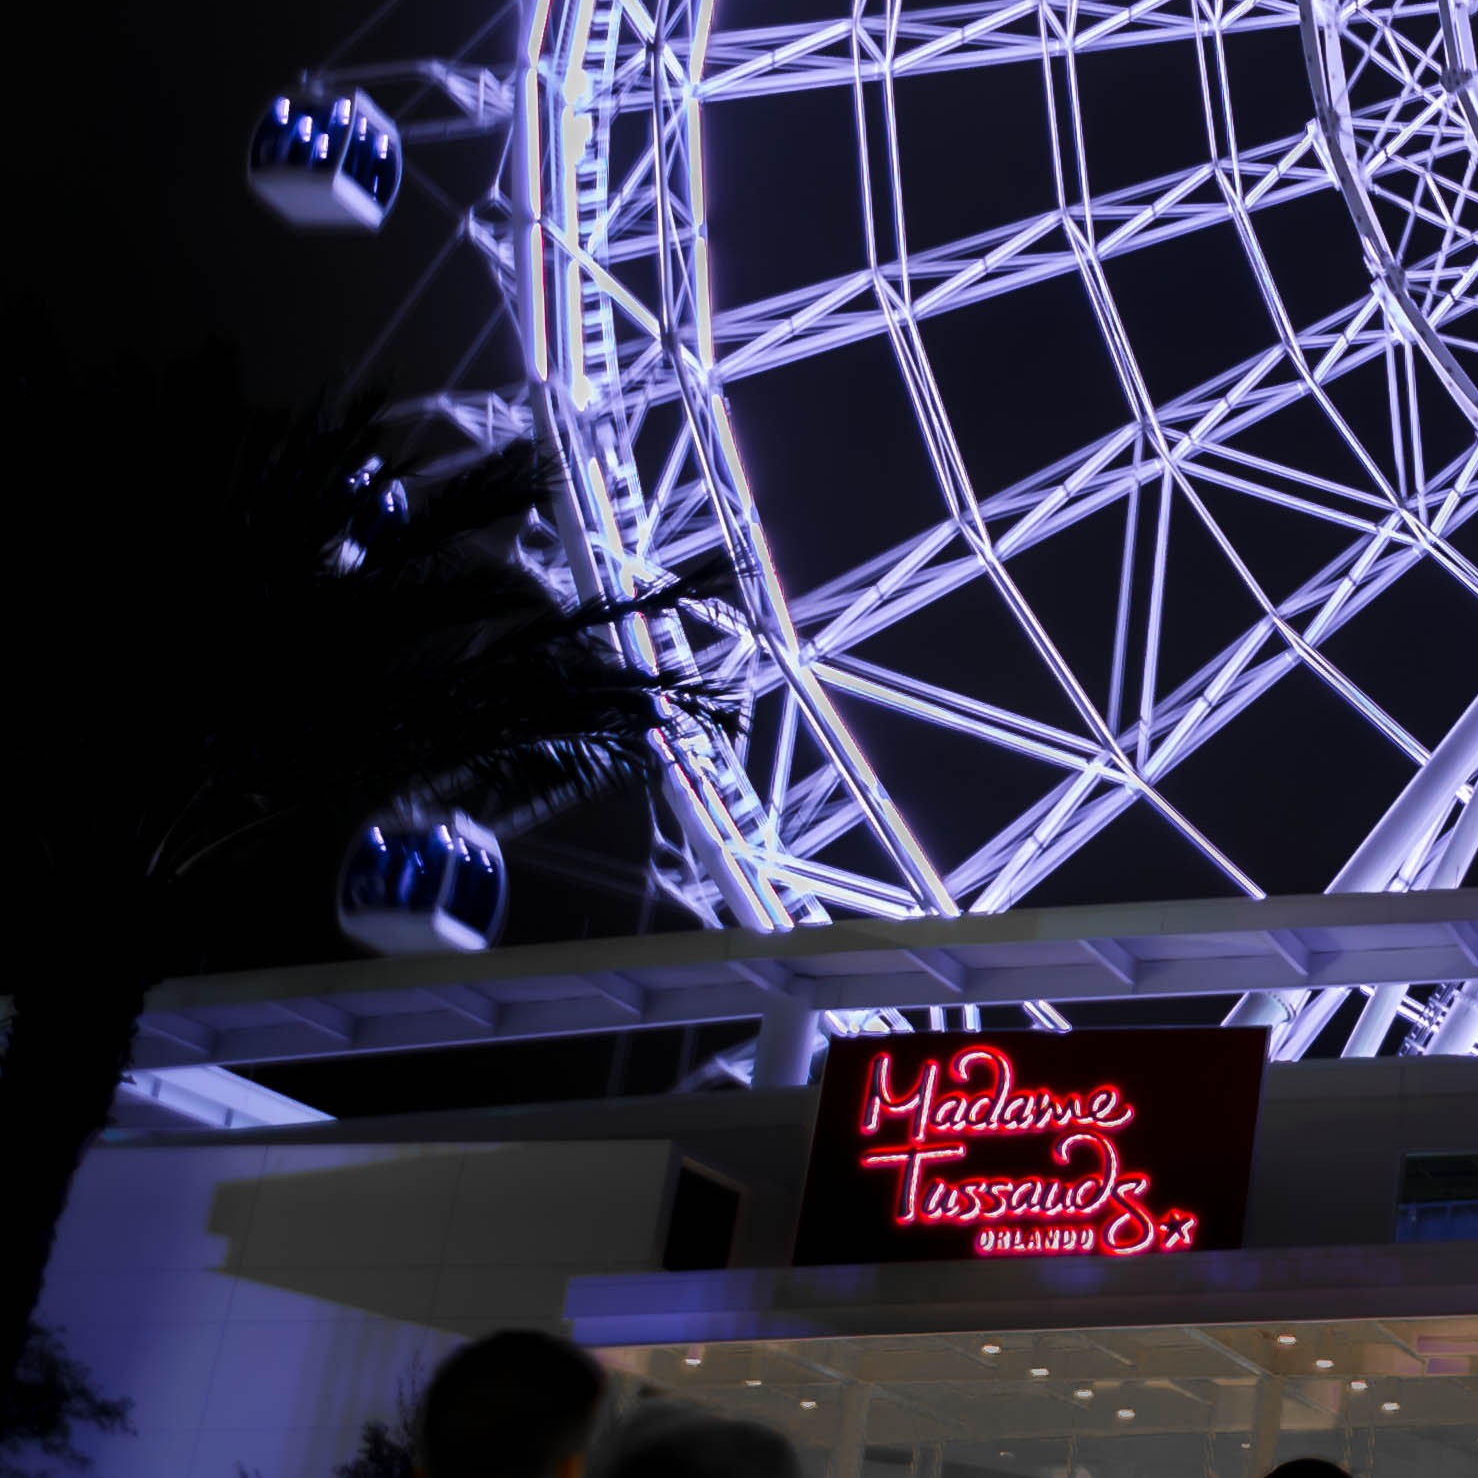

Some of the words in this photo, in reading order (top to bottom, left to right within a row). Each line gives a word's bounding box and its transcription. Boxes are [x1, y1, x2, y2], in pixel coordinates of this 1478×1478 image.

[861, 1045, 1135, 1142] Madame
[861, 1131, 1155, 1254] Tussauds
[975, 1226, 1096, 1252] ORLANDO
